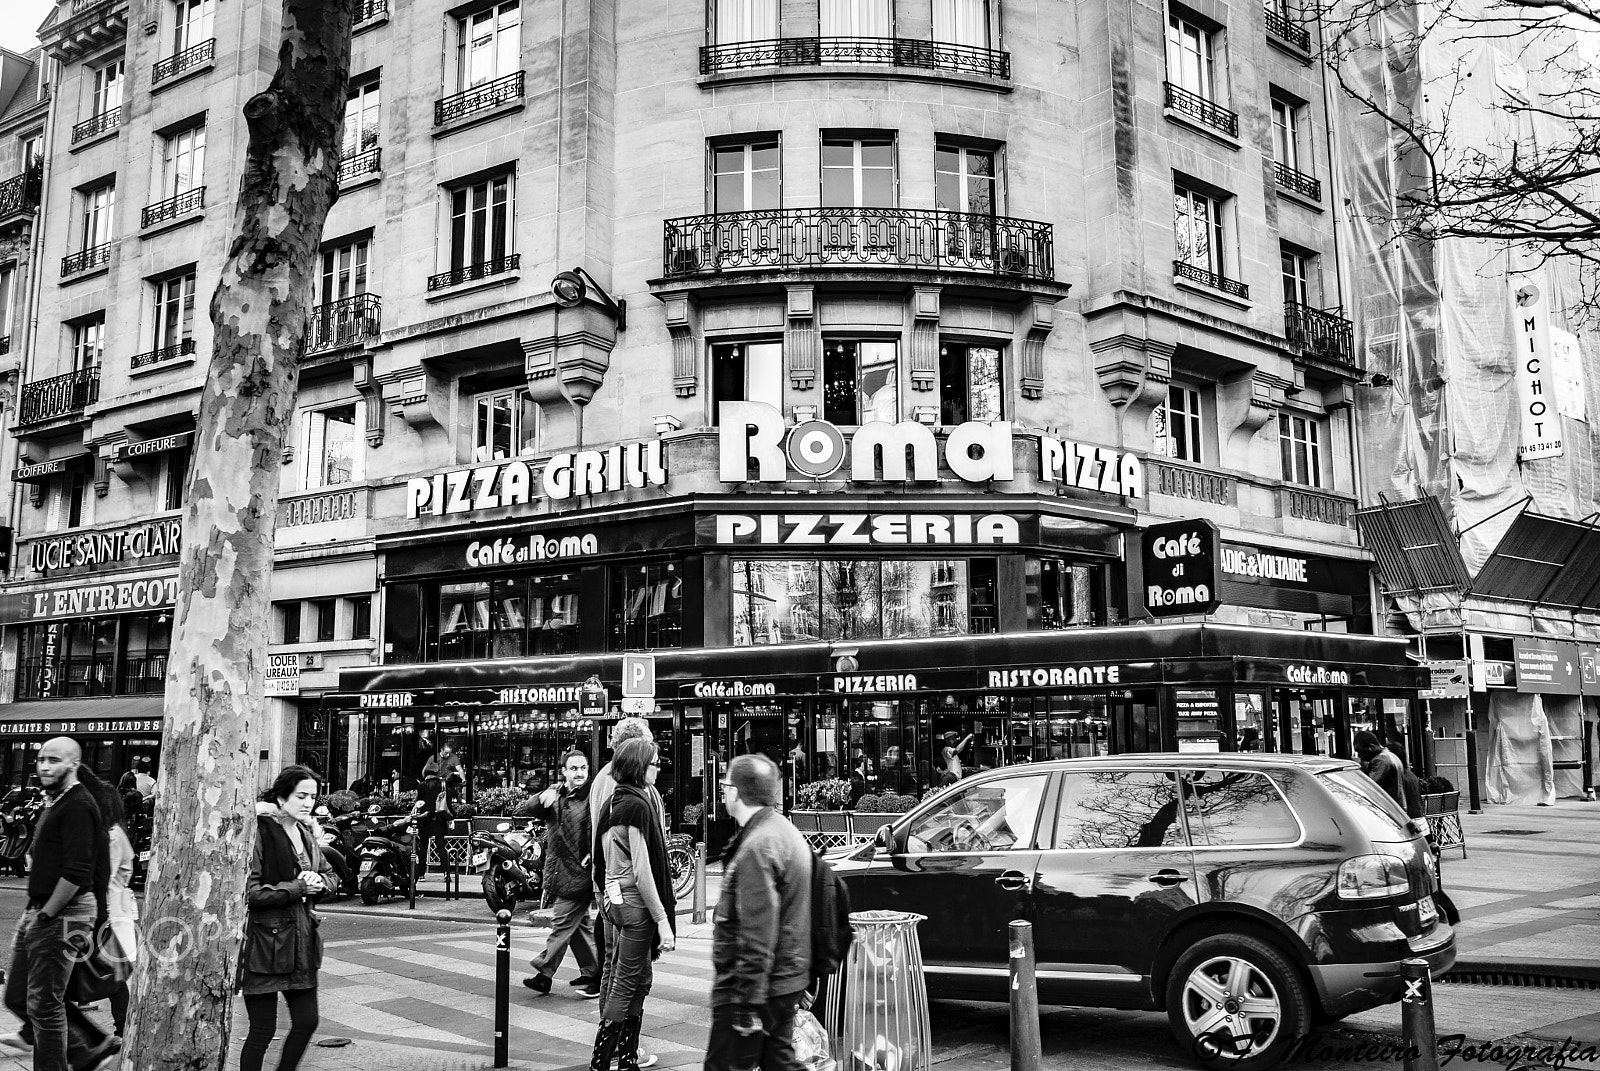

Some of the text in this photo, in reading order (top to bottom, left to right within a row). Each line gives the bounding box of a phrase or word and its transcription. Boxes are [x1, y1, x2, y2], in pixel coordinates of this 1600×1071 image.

[1524, 316, 1546, 437] MICHOT
[127, 436, 176, 456] COIFFURE
[719, 401, 1014, 483] Roma
[1520, 446, 1528, 454] 01
[1529, 445, 1536, 453] 45
[1537, 443, 1545, 451] 73
[1554, 440, 1562, 449] 20
[17, 463, 59, 478] COIFFURE
[1038, 434, 1142, 498] PIZZA
[407, 439, 666, 519] PIZZA GRILL
[716, 514, 1019, 544] PIZZERIA
[31, 524, 181, 572] LUCIE SAINT-CLAIR
[465, 533, 598, 567] Café di Roma
[1153, 532, 1201, 559] Café
[1172, 563, 1184, 577] di
[1148, 584, 1210, 607] Roma
[270, 655, 297, 667] LOUER
[266, 667, 298, 678] UREAUX
[633, 662, 646, 688] P
[988, 666, 1119, 688] RISTORANTE
[1287, 665, 1311, 683] Café
[1317, 666, 1348, 684] Roma
[694, 681, 725, 697] Café
[734, 681, 775, 696] Roma
[834, 674, 917, 692] PIZZERIA
[360, 694, 412, 707] PIZZERIA
[500, 687, 582, 703] RISTORANTE
[61, 723, 76, 732] DE
[88, 720, 160, 732] GRILLADES
